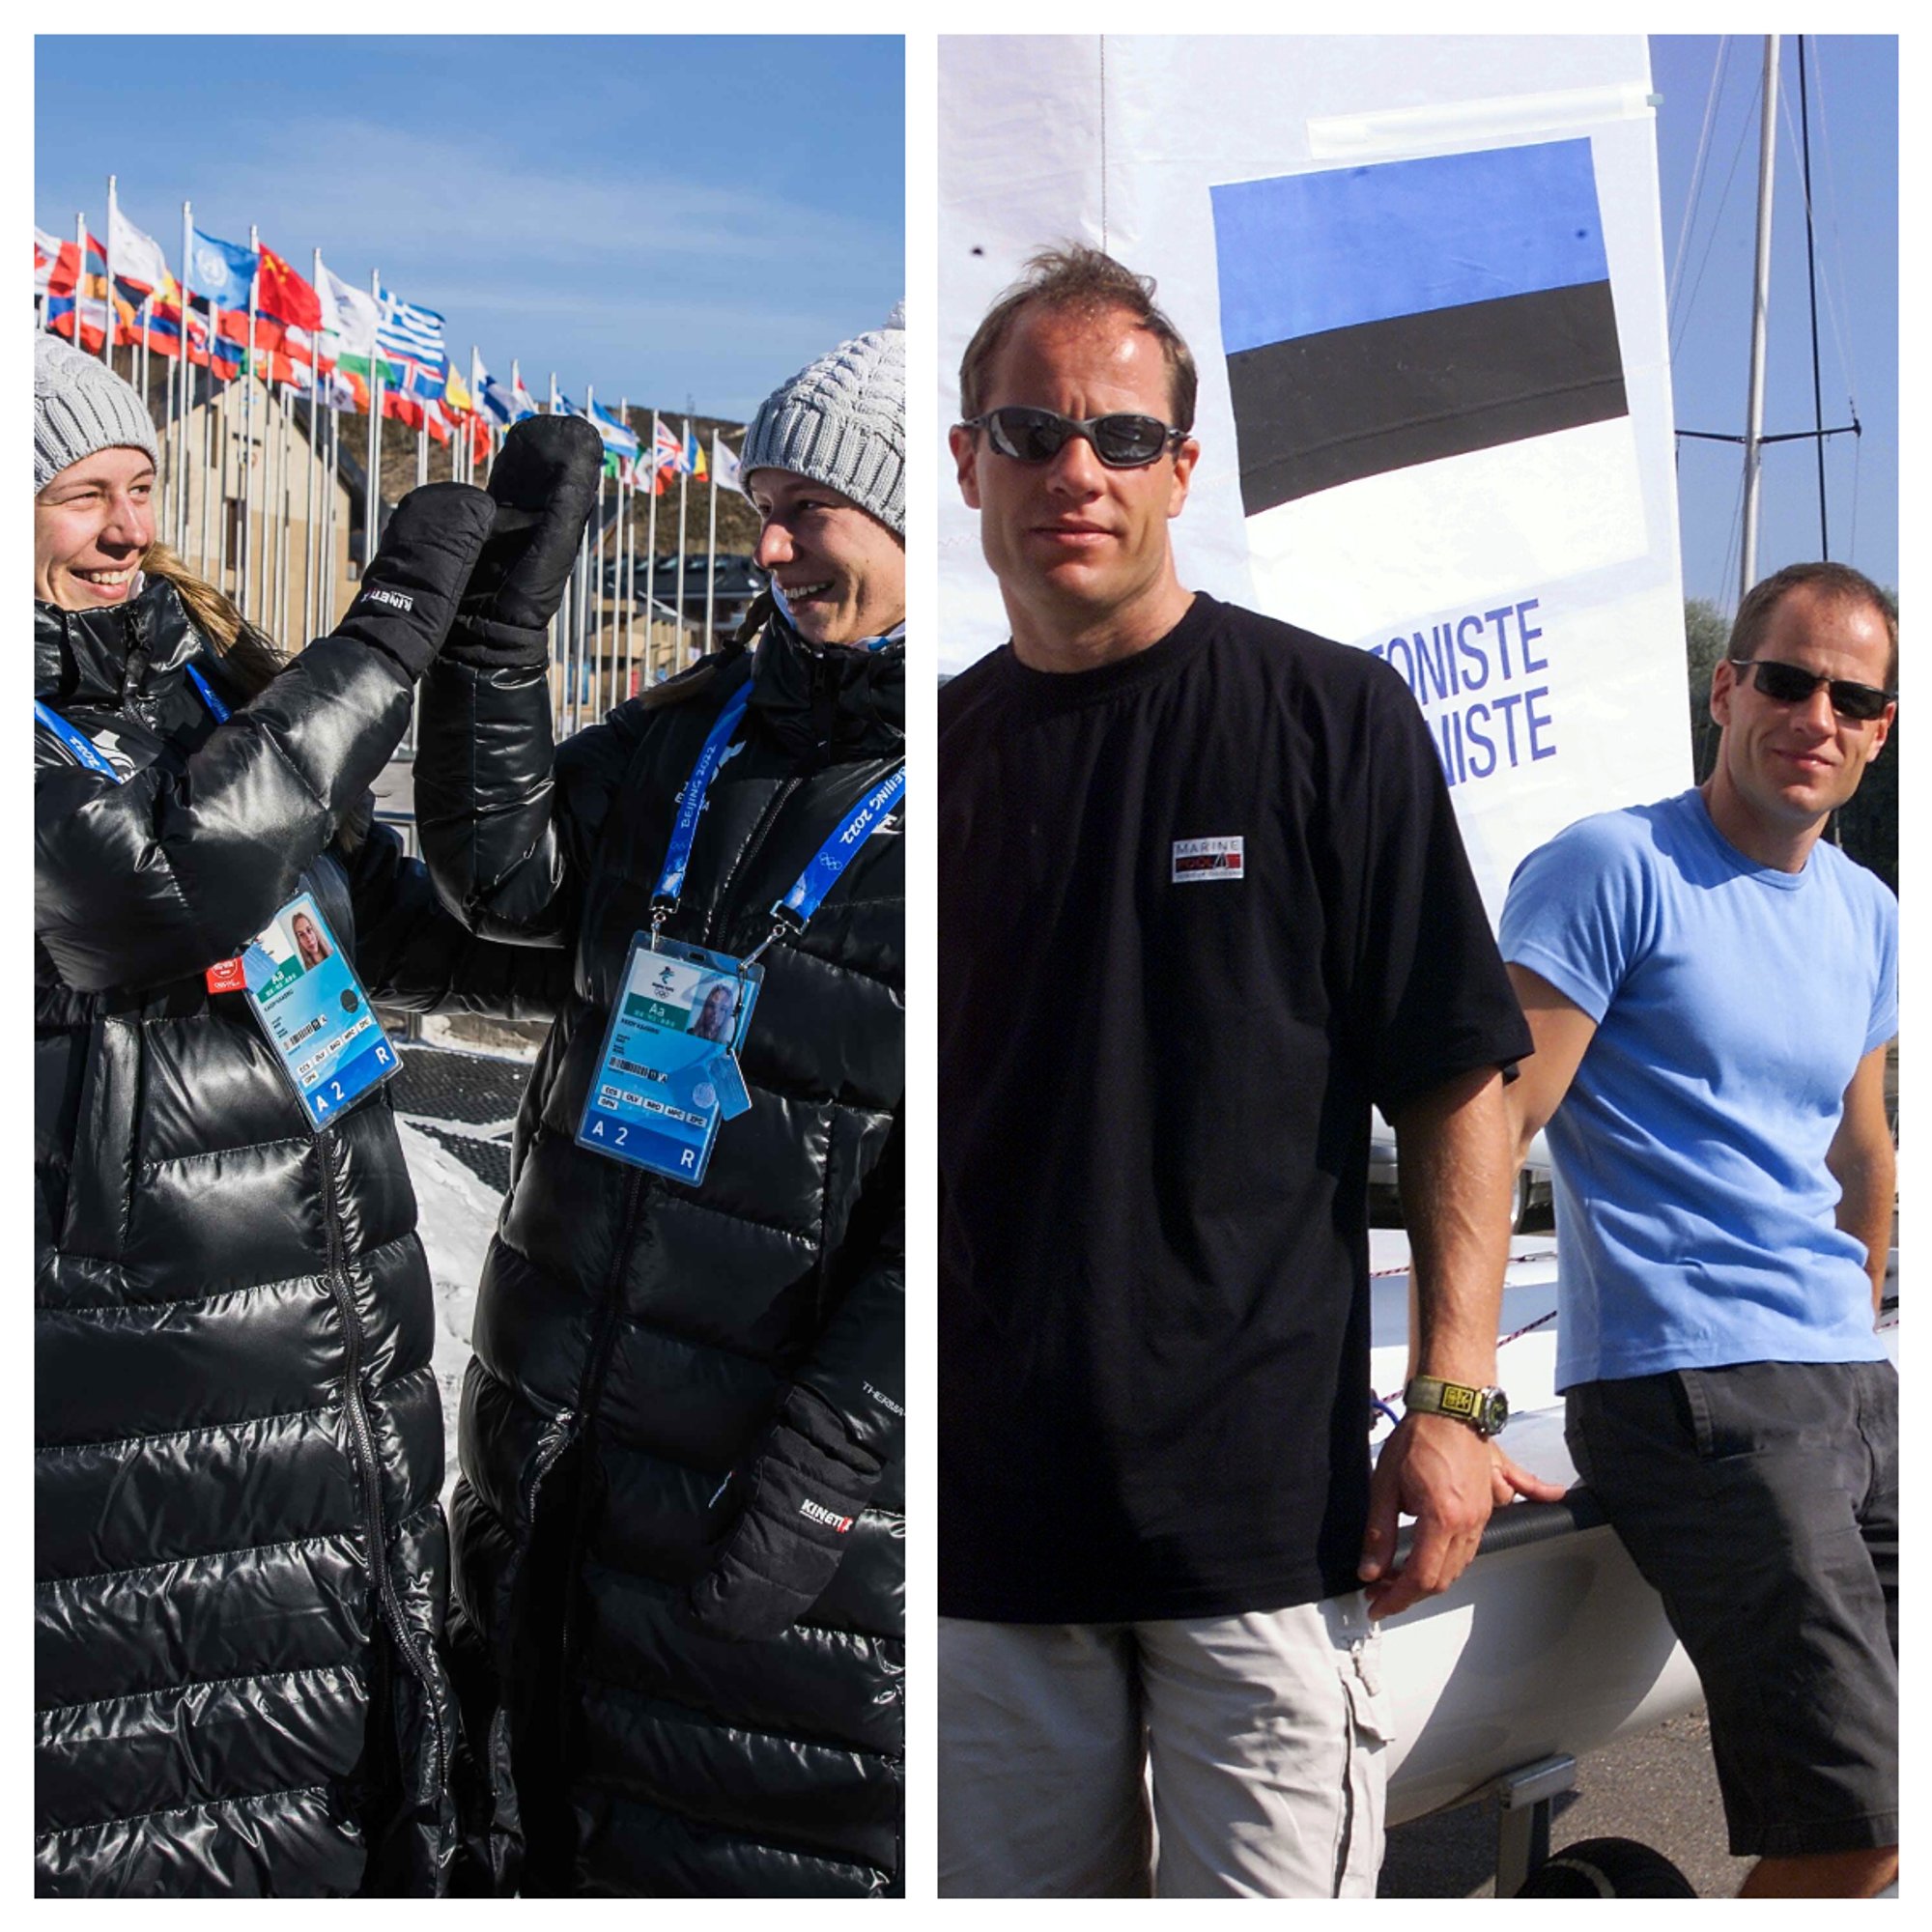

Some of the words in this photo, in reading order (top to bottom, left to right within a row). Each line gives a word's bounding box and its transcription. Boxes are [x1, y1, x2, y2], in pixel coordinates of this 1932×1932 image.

[1367, 598, 1548, 705] ONISTE
[681, 780, 702, 828] BEIJING
[696, 744, 718, 776] 2022
[838, 809, 873, 844] 2022
[1176, 839, 1239, 854] MARINE
[647, 1003, 666, 1017] Aa
[316, 1094, 328, 1113] A
[330, 1081, 345, 1100] 2
[375, 1046, 390, 1065] R
[592, 1120, 604, 1137] A
[614, 1126, 629, 1146] 2
[680, 1149, 696, 1169] R
[863, 1380, 905, 1416] THERMA
